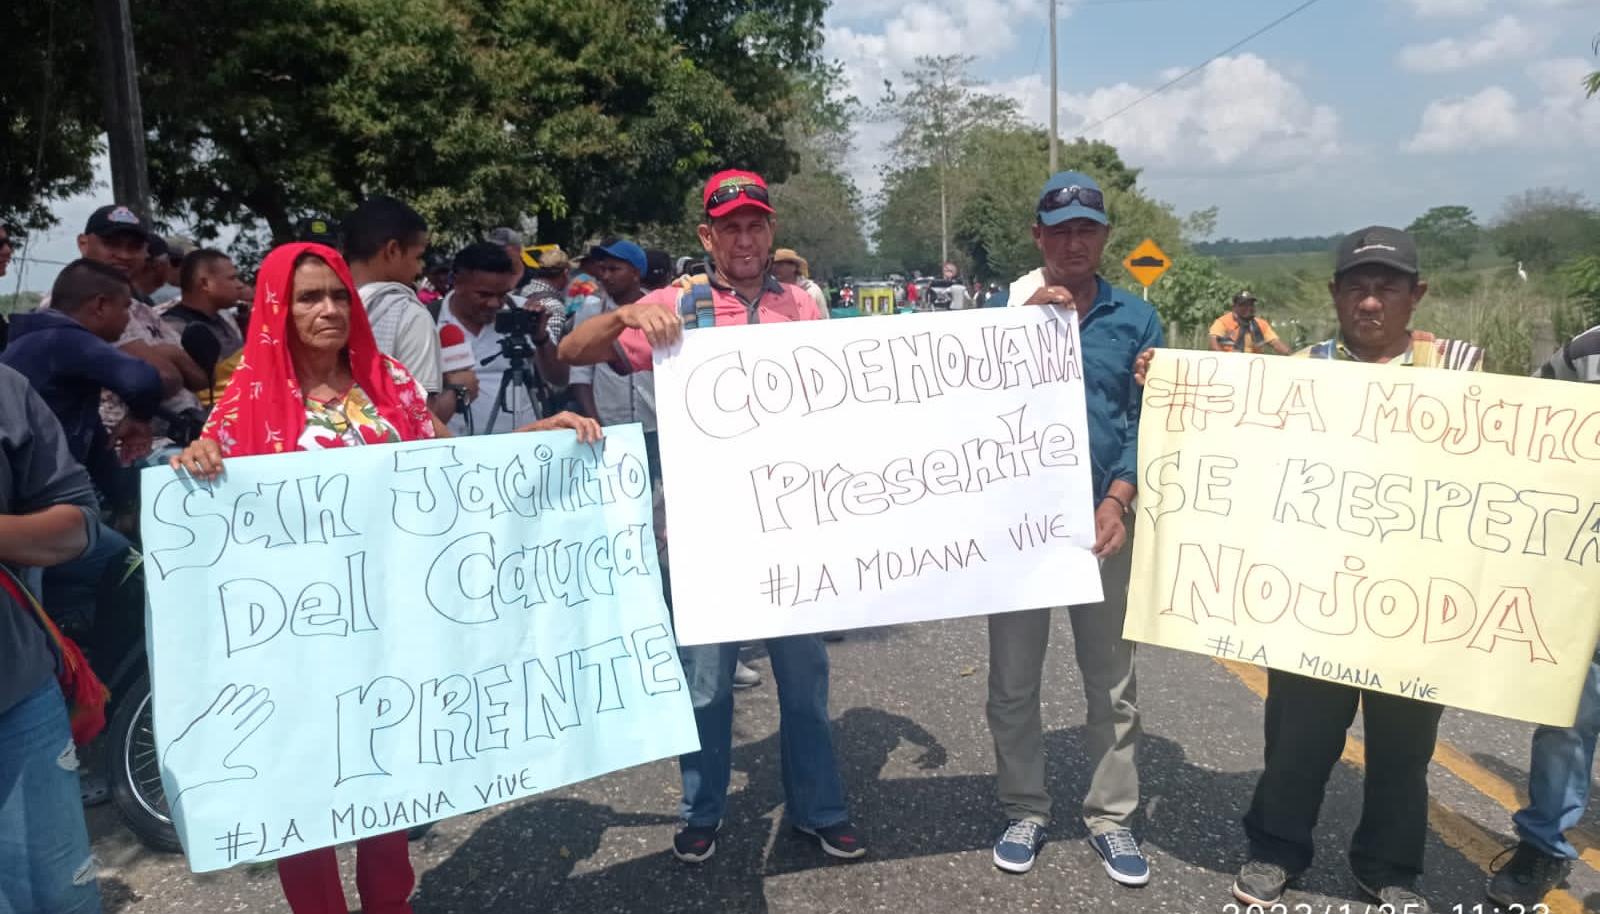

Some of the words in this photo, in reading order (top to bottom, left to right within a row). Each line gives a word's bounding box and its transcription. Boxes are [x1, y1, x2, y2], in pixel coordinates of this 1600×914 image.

[1146, 357, 1326, 432] #LA
[750, 404, 1078, 533] Presente
[1144, 451, 1238, 530] SE
[151, 474, 361, 580] San
[389, 437, 646, 536] Jacinto
[218, 552, 378, 658] Del
[426, 523, 650, 624] Cauca
[760, 564, 838, 606] #LA
[856, 539, 987, 591] MOJANA
[1205, 635, 1268, 664] #LA
[1300, 652, 1382, 688] MOJANA
[334, 623, 681, 787] PRENTE
[215, 819, 304, 861] #LA
[332, 790, 455, 838] MOJANA
